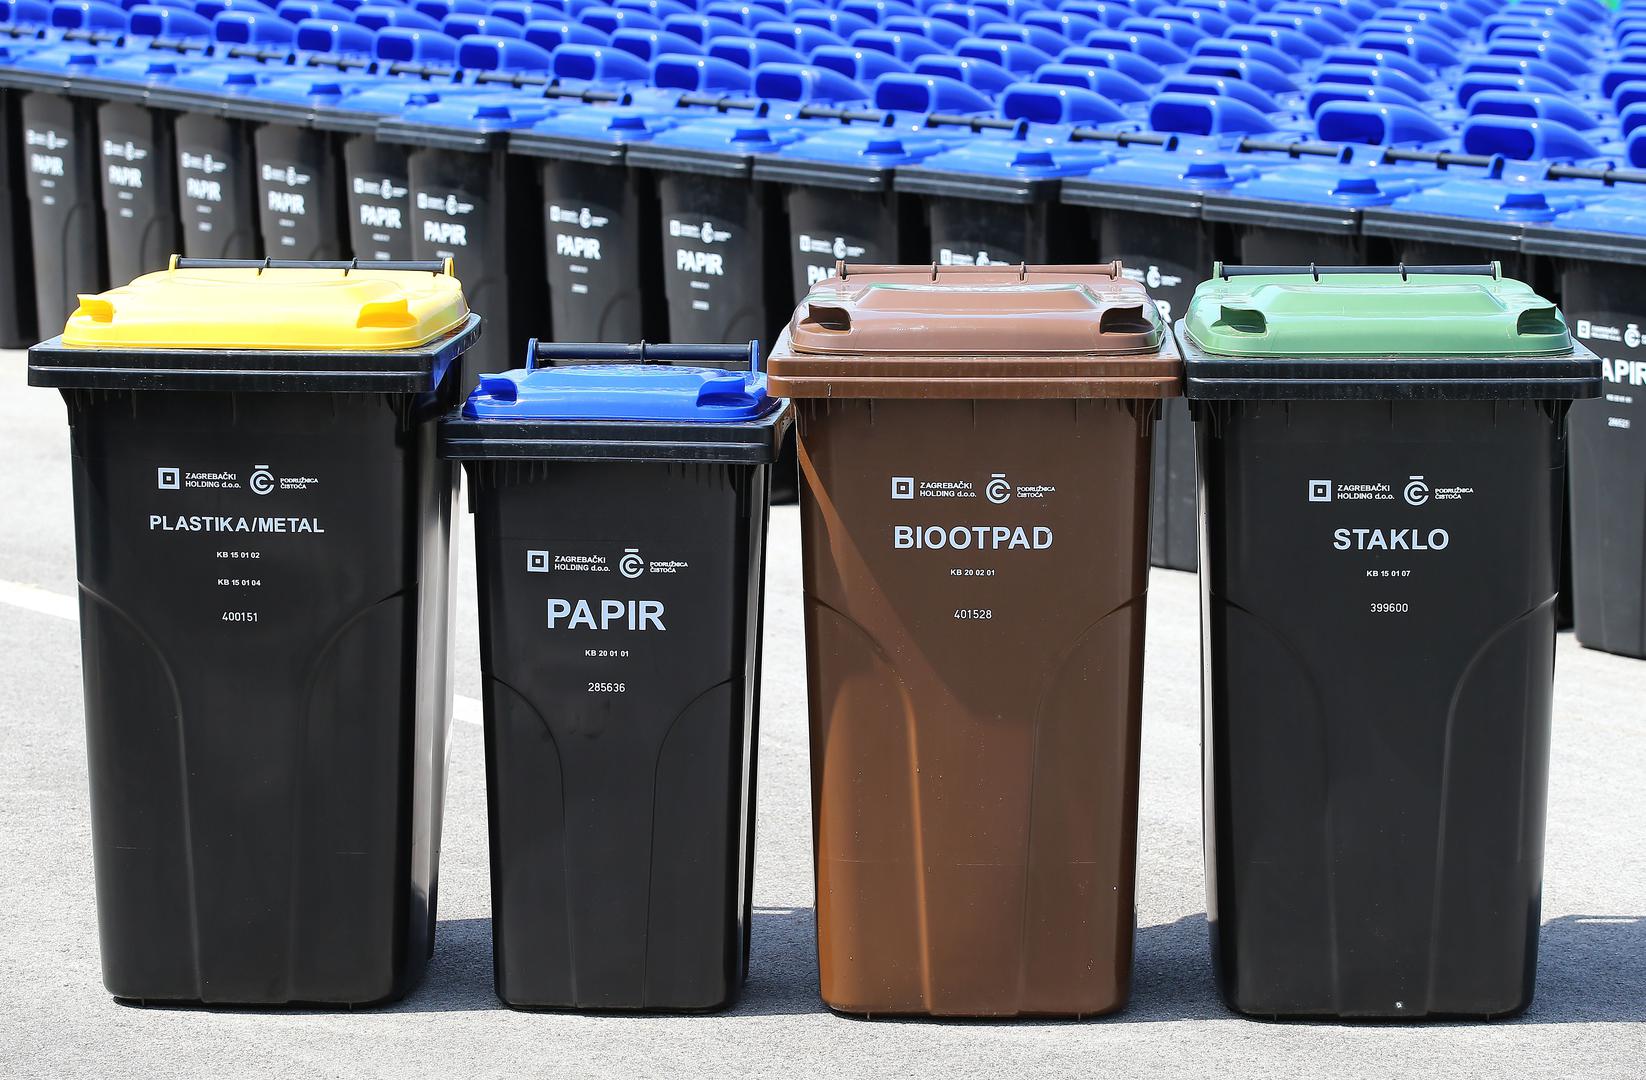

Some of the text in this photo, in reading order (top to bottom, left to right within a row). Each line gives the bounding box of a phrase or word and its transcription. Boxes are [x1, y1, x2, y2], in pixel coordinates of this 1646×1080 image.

[1602, 357, 1646, 386] APIR
[185, 472, 236, 480] ZAGREBAČKI
[920, 481, 972, 489] ZAGREBAČKI
[1337, 483, 1390, 492] ZAGREBAČKI
[149, 514, 325, 533] PLASTIKA/METAL
[894, 526, 1053, 550] BIOOTPAD
[1333, 528, 1449, 551] STAKLO
[251, 551, 260, 559] 02
[554, 555, 606, 564] ZAGREBAČKI
[554, 563, 589, 571] HOLDING
[1370, 603, 1409, 613] 399600
[222, 612, 258, 622] 400151
[547, 598, 667, 631] PAPIR
[954, 609, 992, 619] 401528
[588, 682, 626, 692] 285636
